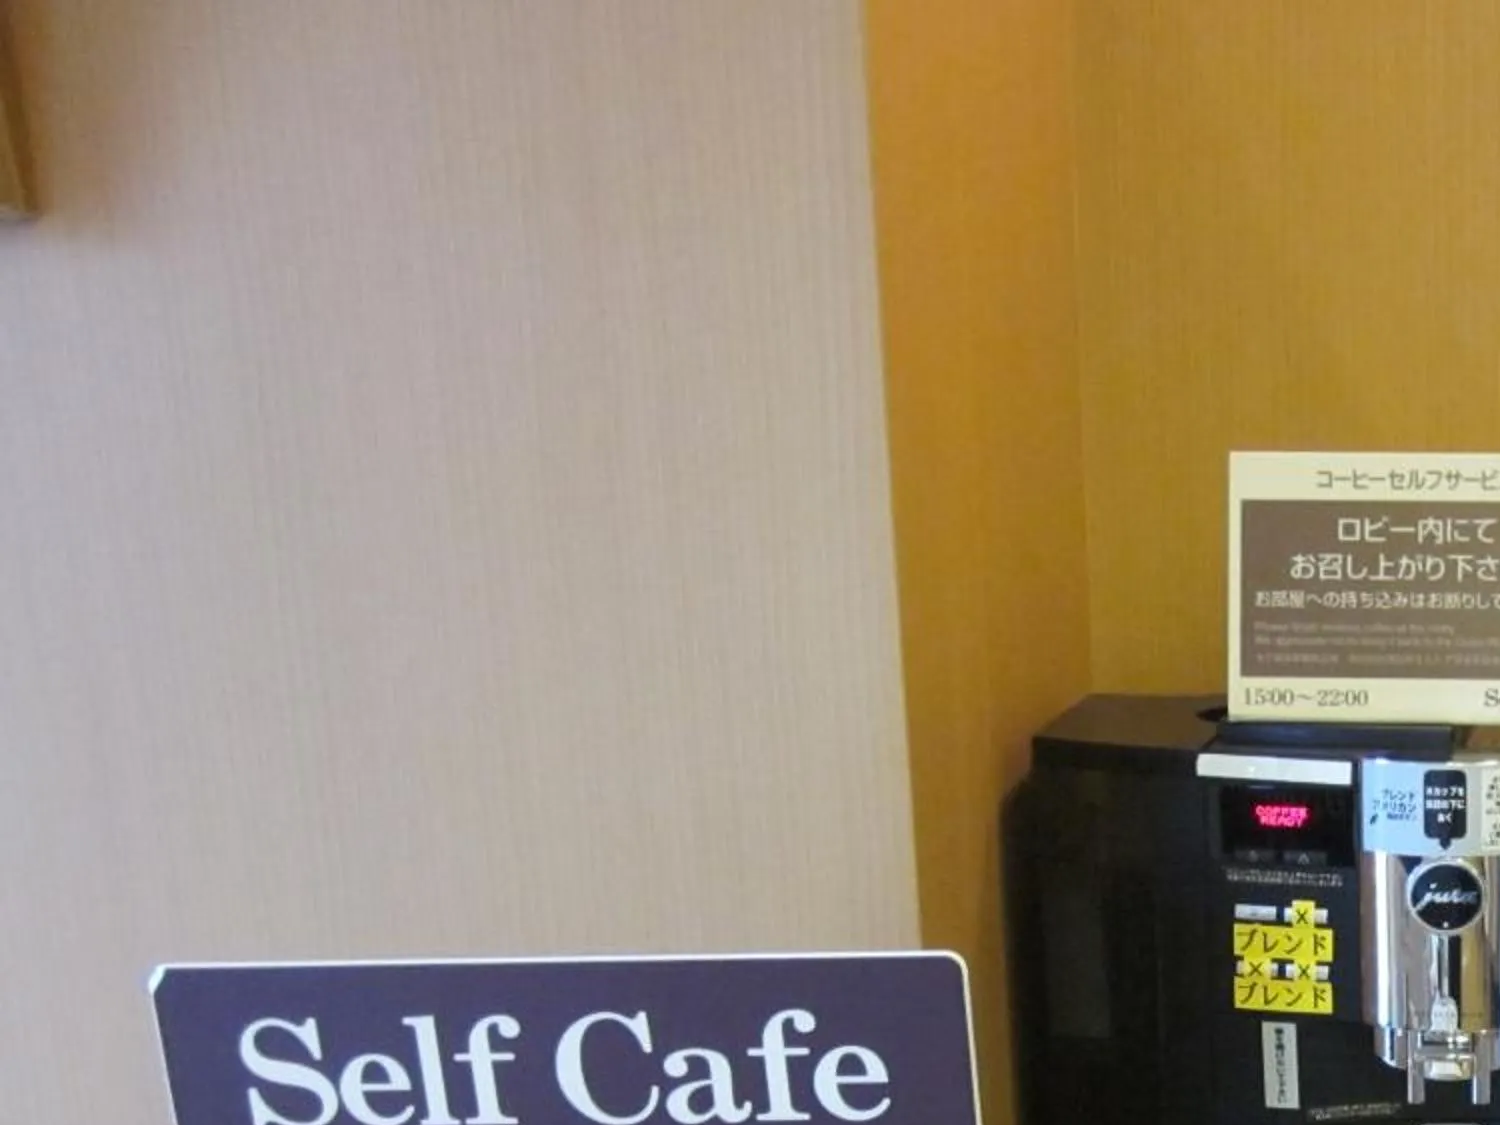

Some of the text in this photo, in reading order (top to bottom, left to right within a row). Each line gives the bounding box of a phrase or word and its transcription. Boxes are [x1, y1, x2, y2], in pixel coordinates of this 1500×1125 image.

[1337, 515, 1498, 545] ロビー内にて
[1235, 928, 1327, 956] ブレンド
[1237, 981, 1327, 1009] ブレンド
